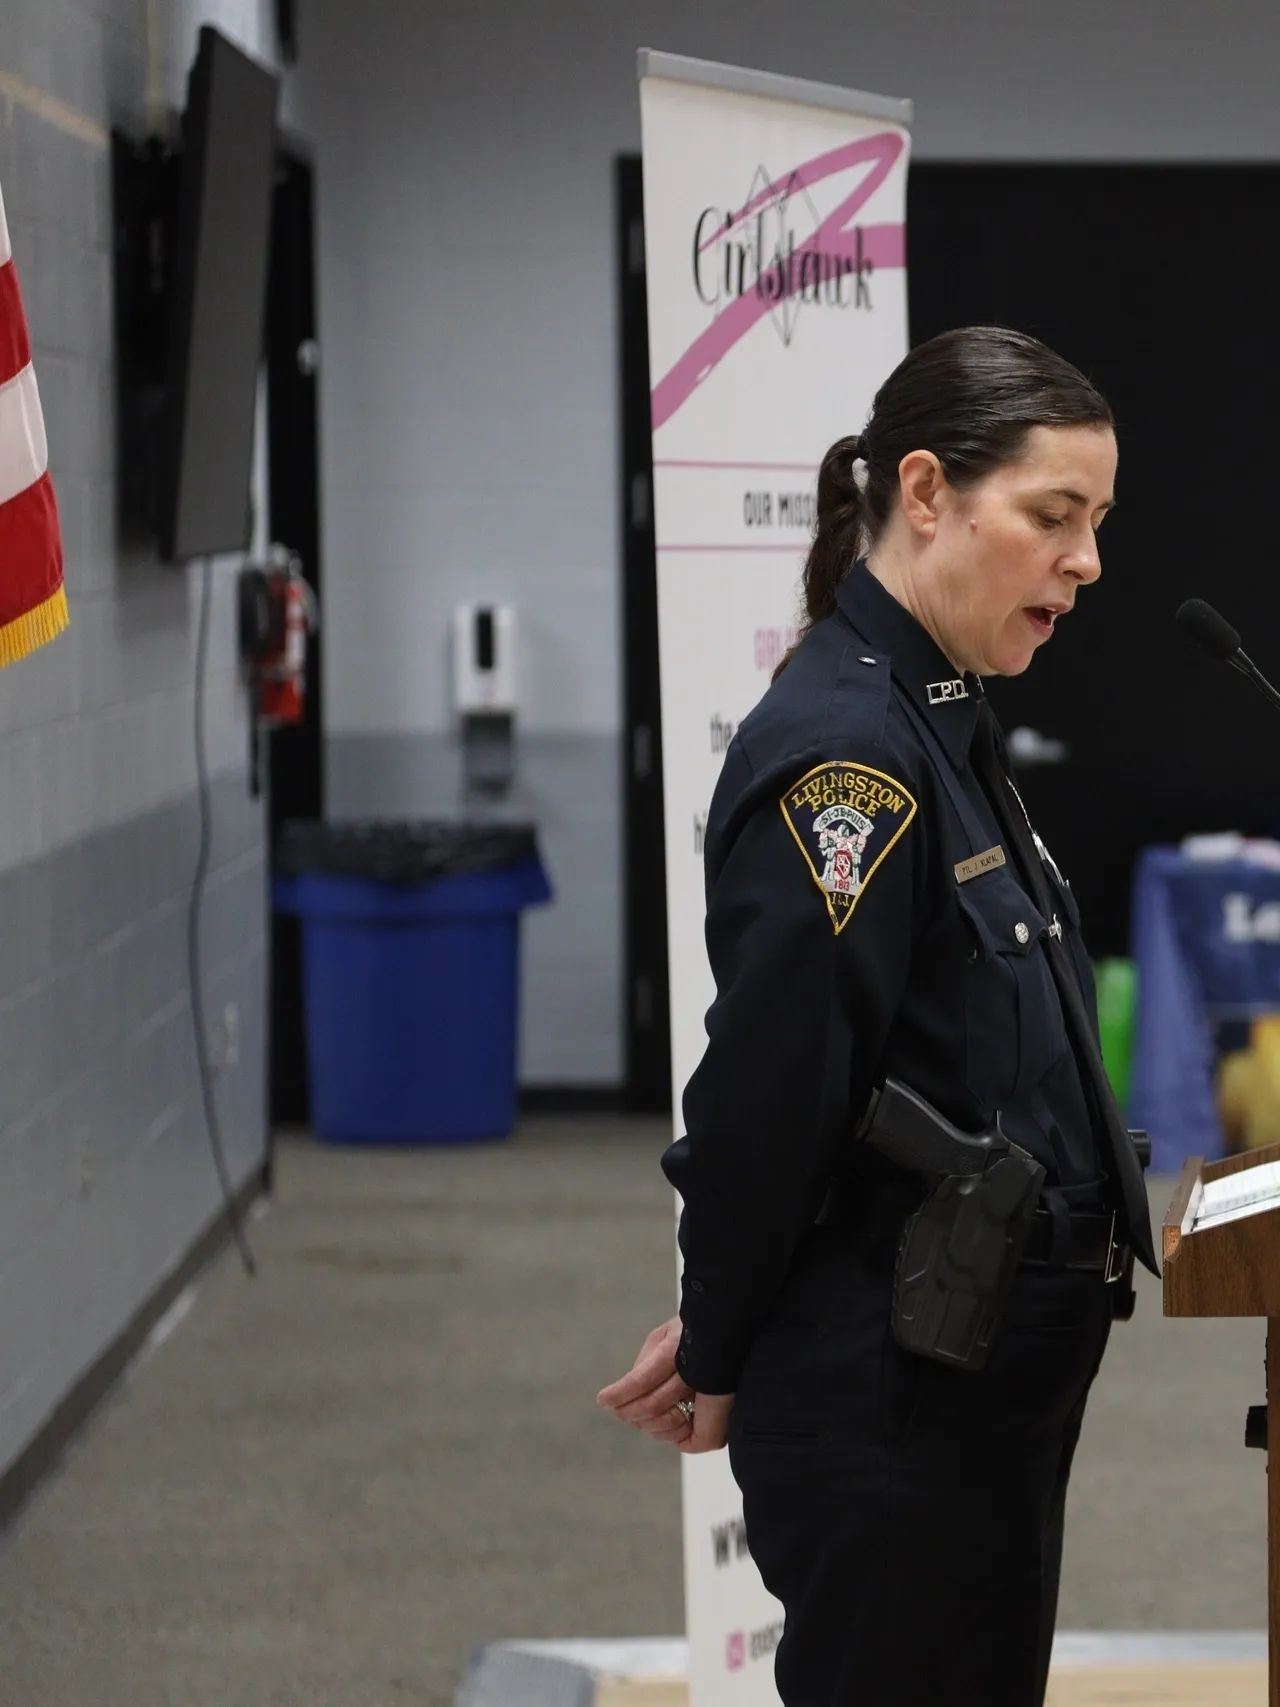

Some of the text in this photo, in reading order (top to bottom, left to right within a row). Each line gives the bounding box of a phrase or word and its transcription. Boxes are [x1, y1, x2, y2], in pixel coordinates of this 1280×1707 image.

[743, 491, 772, 527] OUR
[791, 771, 906, 814] LIVINGSTON
[808, 788, 881, 818] POLICE
[834, 879, 850, 891] 1813
